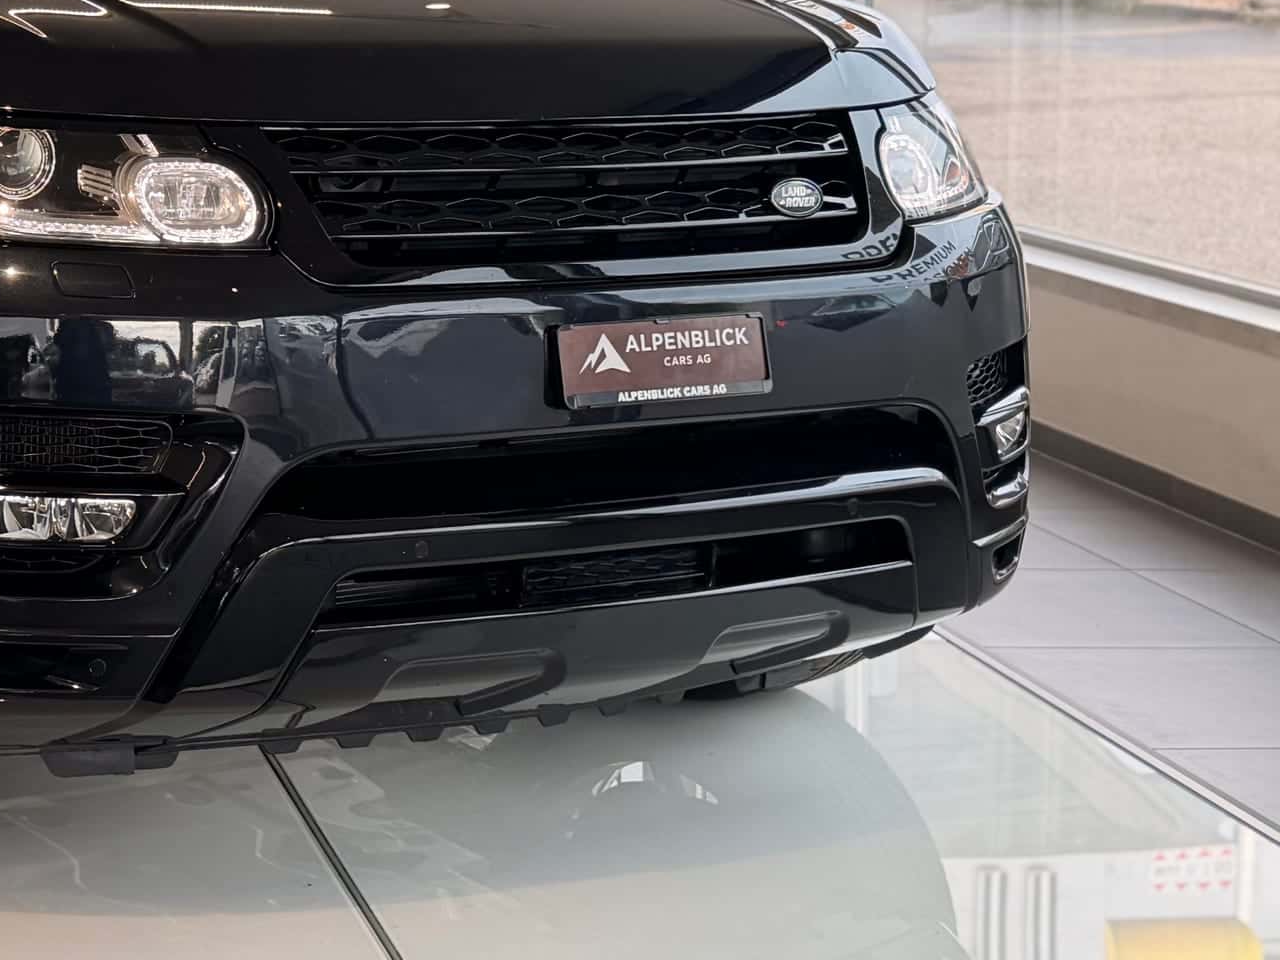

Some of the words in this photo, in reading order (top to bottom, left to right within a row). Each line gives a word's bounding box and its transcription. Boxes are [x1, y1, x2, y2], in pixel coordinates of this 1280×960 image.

[782, 186, 806, 197] LAND
[785, 196, 815, 208] ROVER
[625, 327, 749, 353] ALPENBLICK
[664, 355, 693, 366] CARS
[696, 354, 711, 365] AG
[618, 386, 682, 402] ALPENBLICK
[683, 385, 711, 398] CARS
[712, 384, 727, 395] AG
